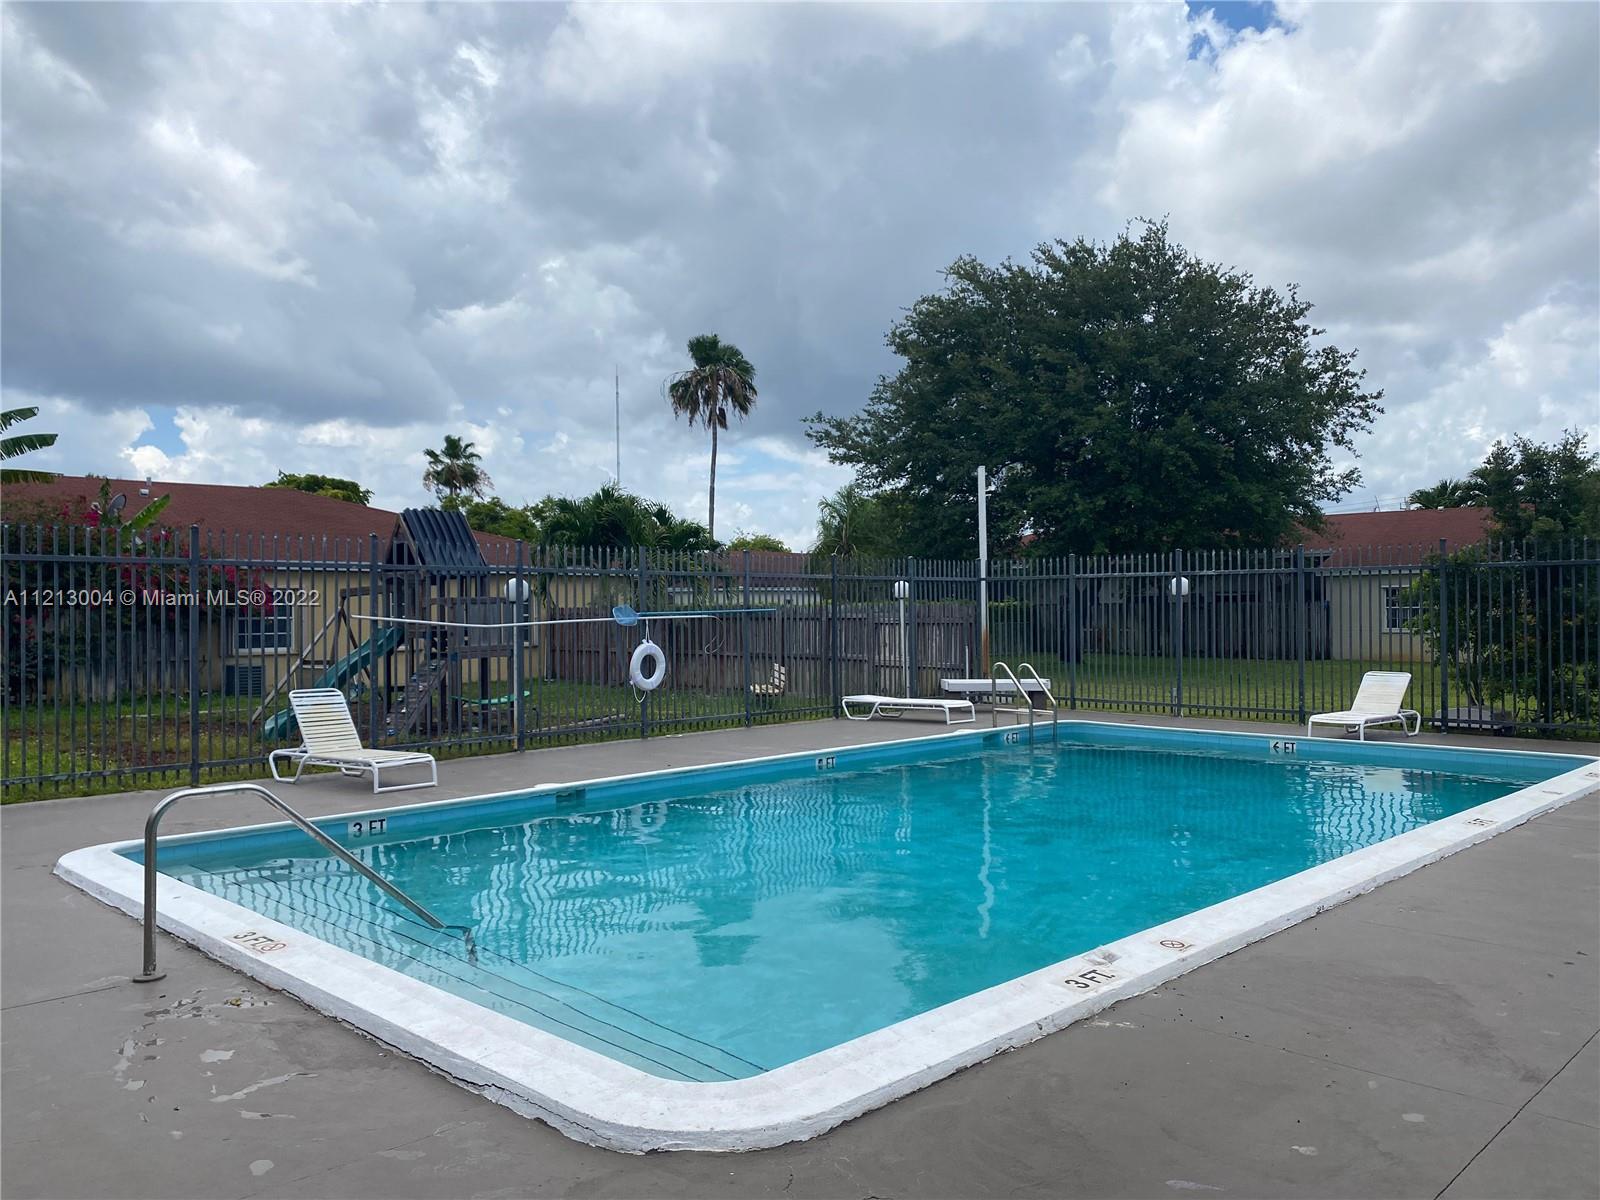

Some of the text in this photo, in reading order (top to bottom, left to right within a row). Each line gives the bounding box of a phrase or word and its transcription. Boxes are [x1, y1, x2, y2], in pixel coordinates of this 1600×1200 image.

[352, 819, 386, 836] 3 FT
[233, 931, 257, 940] 3
[1064, 979, 1090, 989] 3
